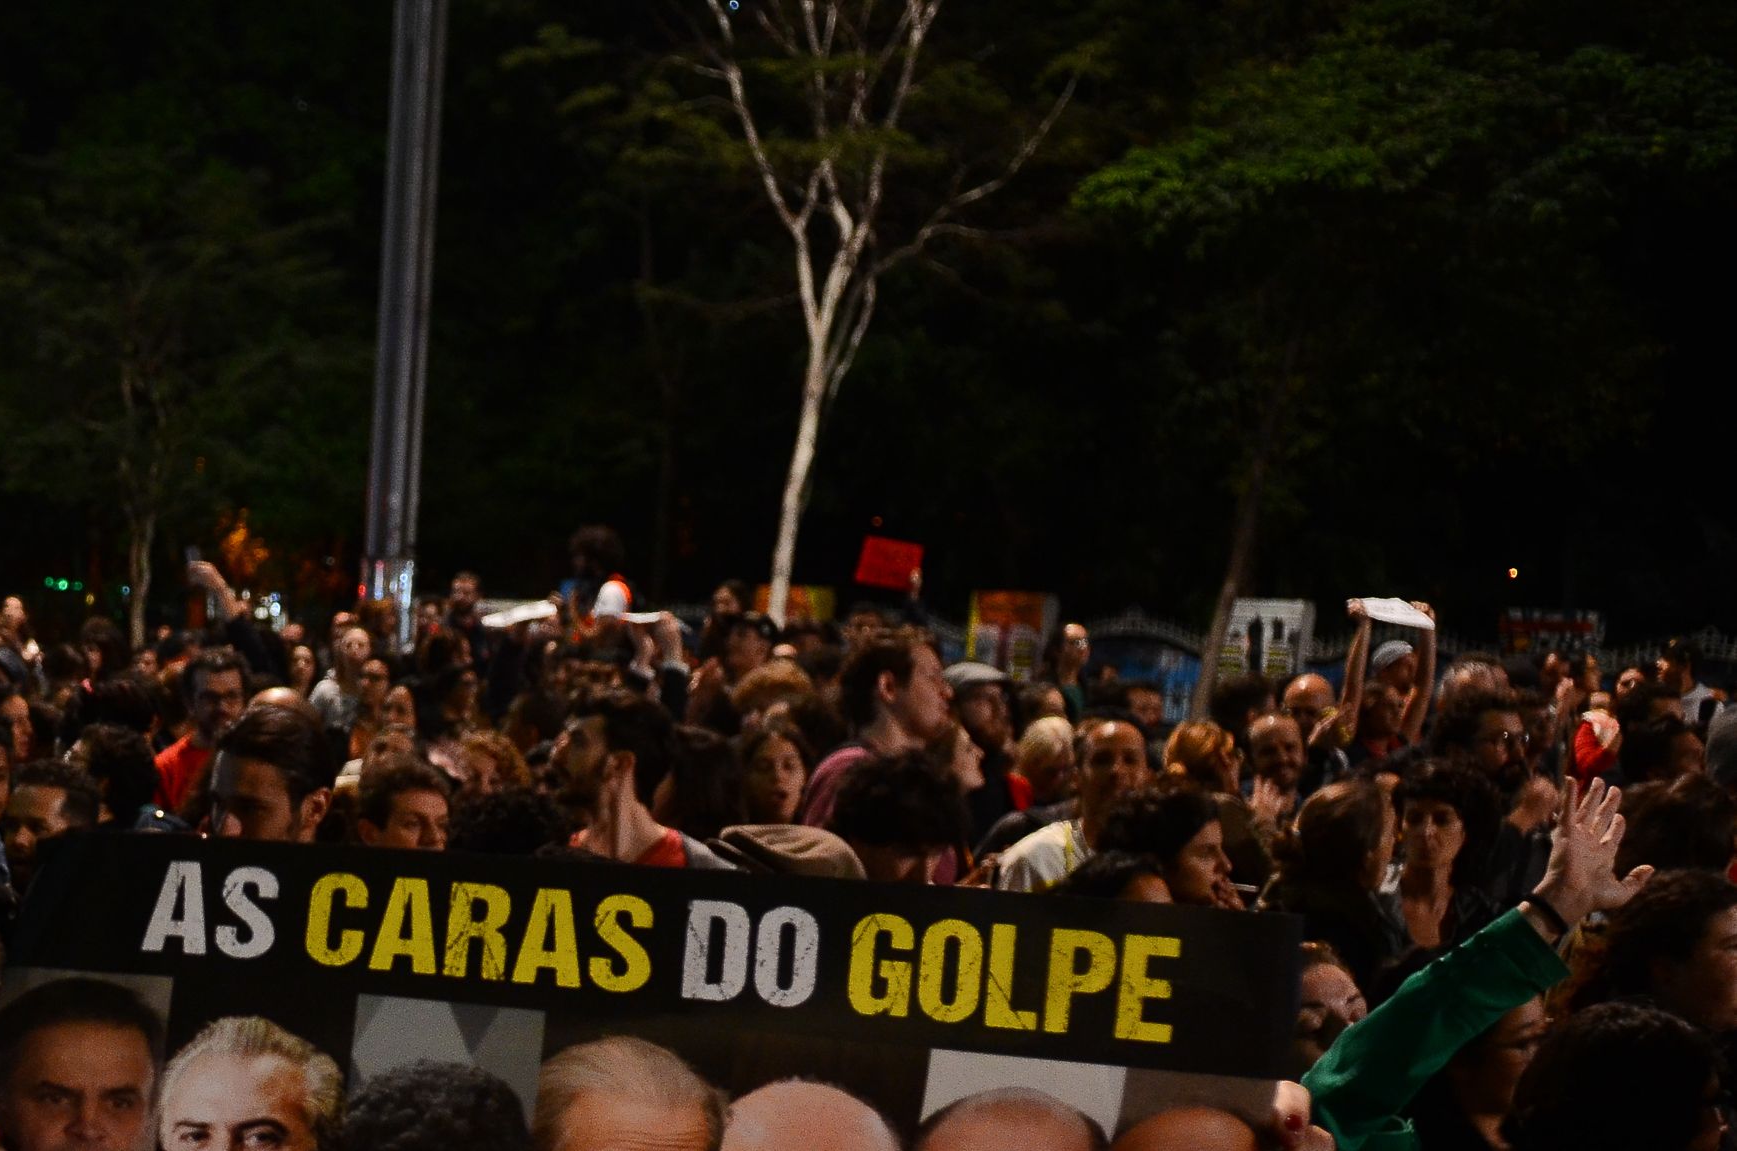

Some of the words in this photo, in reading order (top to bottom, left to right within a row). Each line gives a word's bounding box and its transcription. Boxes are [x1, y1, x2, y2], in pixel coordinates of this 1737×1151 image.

[140, 859, 280, 960] AS
[303, 871, 656, 995] CARAS
[679, 899, 820, 1008] DO
[847, 912, 1183, 1044] GOLPE
